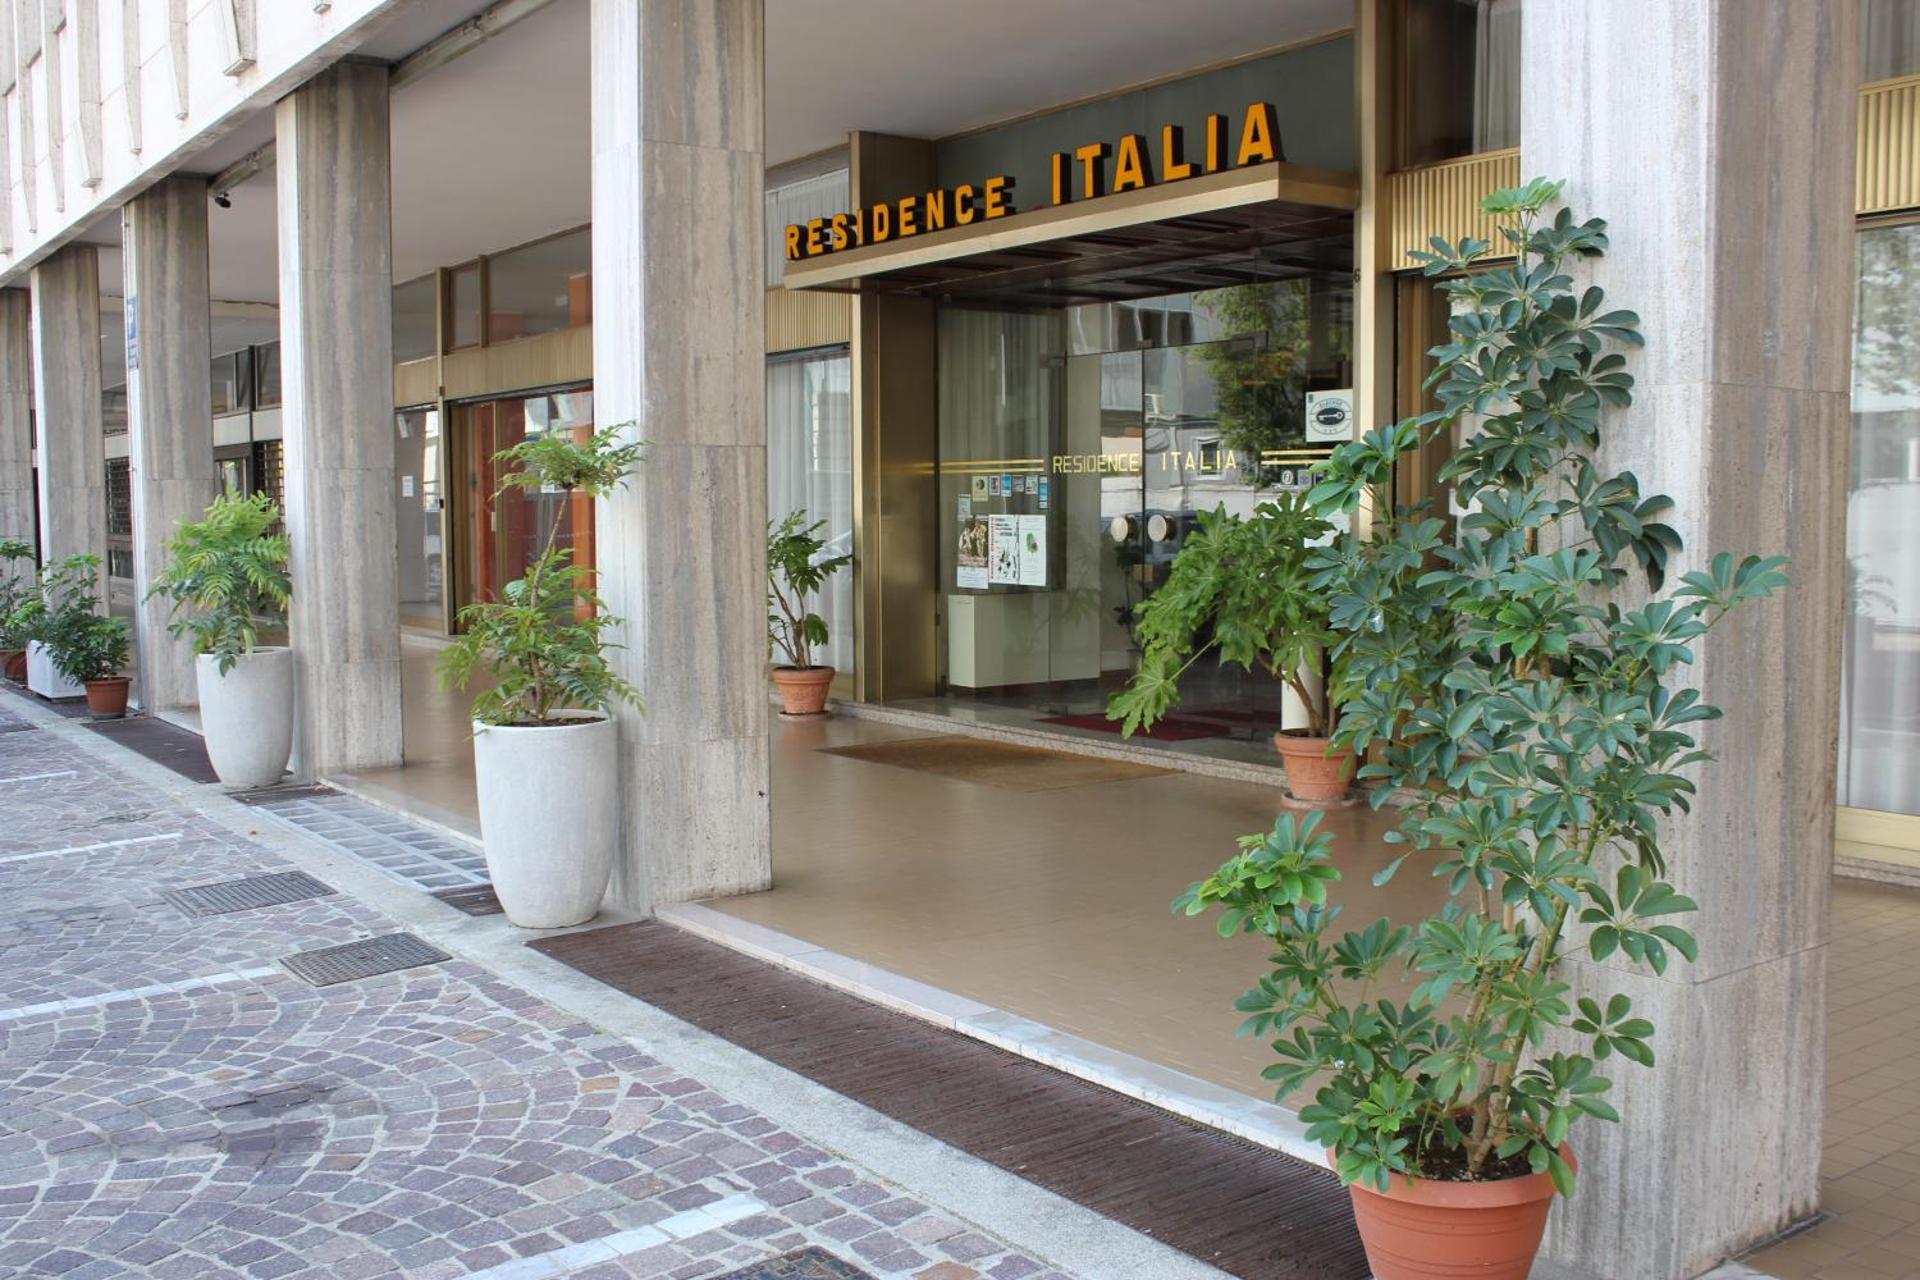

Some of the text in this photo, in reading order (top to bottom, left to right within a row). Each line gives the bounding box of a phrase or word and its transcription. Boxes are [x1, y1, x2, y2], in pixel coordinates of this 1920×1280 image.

[785, 102, 1280, 260] RESIDENCE ITALIA
[1053, 450, 1237, 474] RESIDENCE ITALIA
